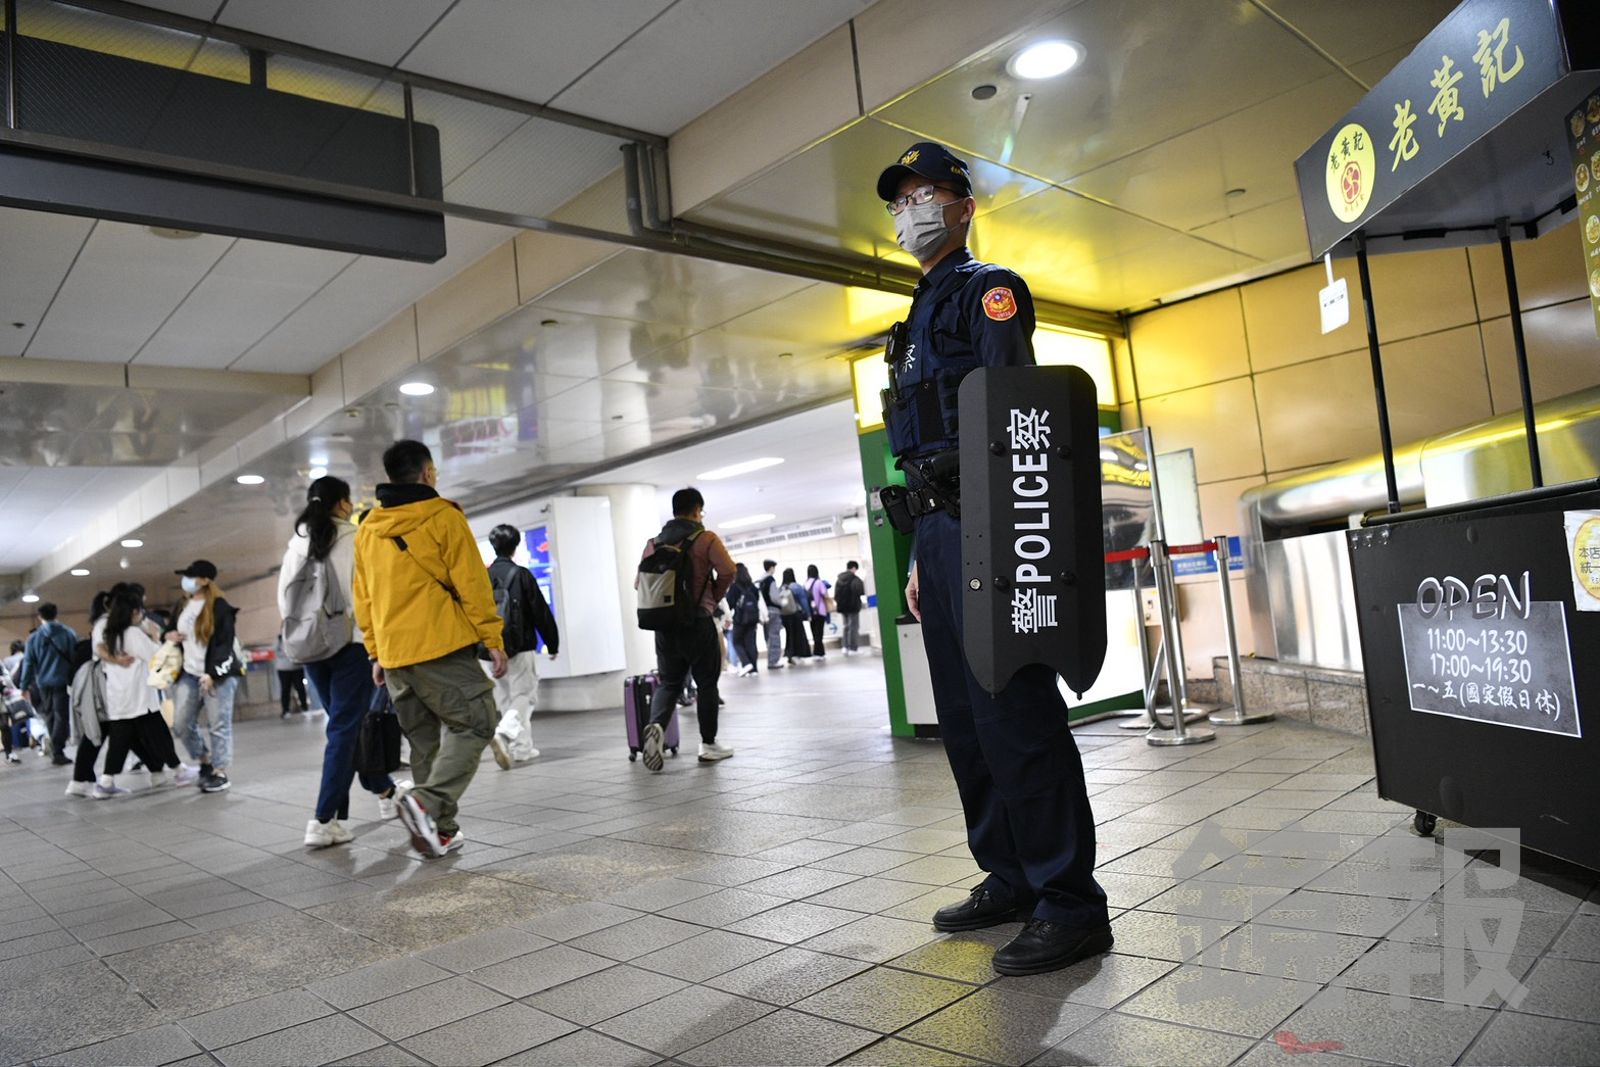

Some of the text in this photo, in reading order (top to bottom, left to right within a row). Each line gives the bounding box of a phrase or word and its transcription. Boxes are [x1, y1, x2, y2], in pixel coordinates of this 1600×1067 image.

[1417, 570, 1530, 620] OPEN
[1427, 628, 1528, 655] 11:00~13:30
[1430, 653, 1532, 684] 17:00~19:30
